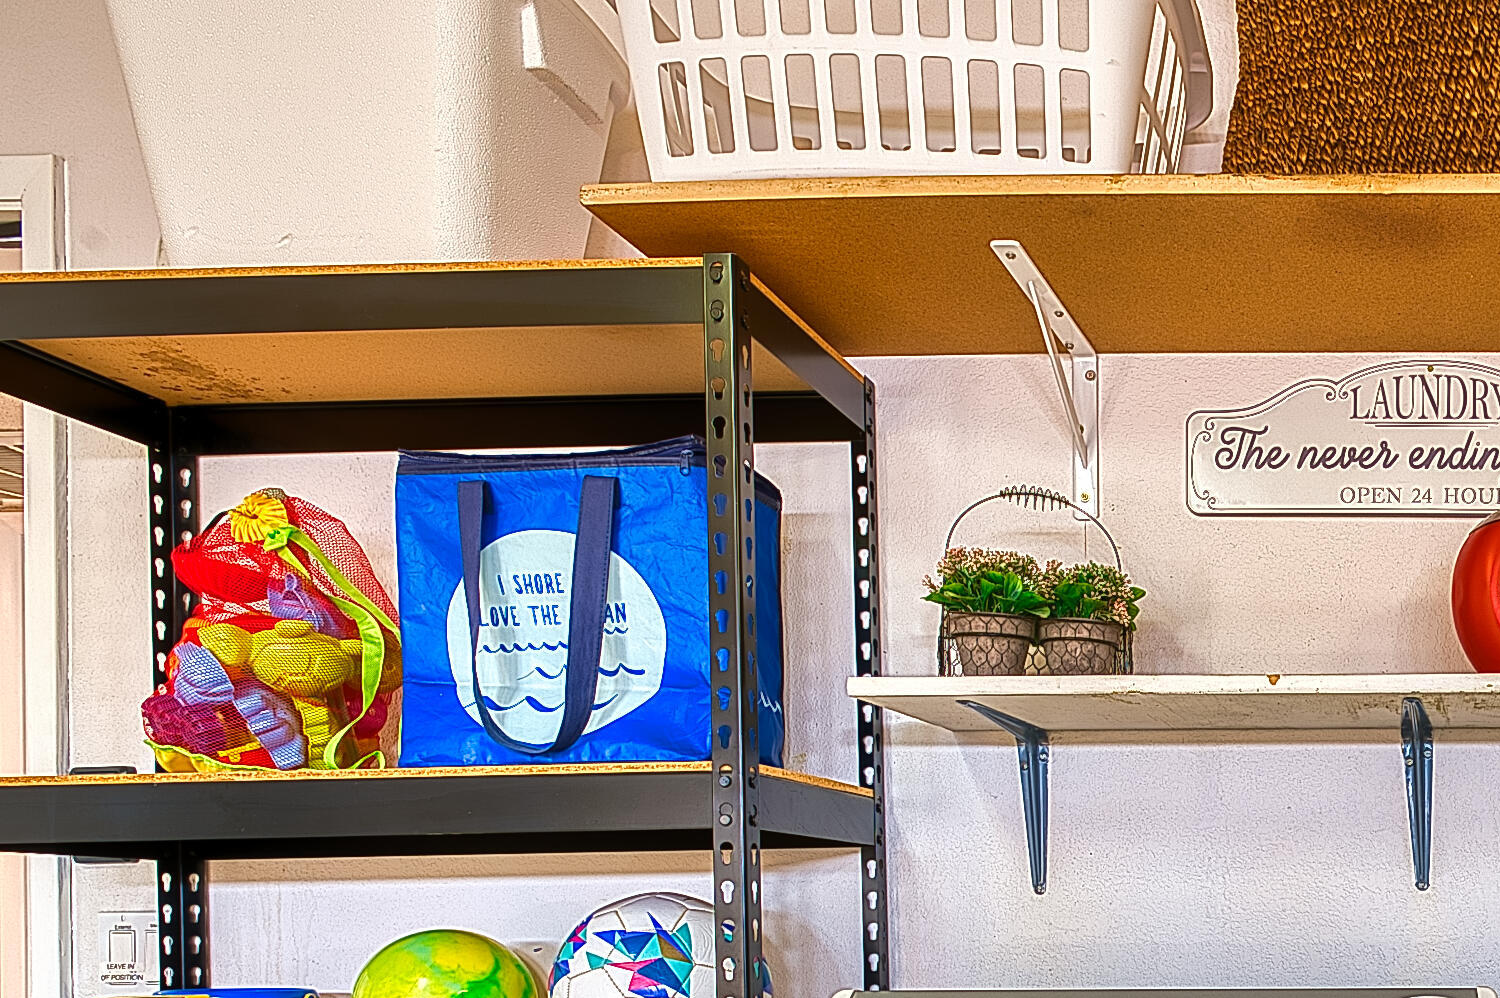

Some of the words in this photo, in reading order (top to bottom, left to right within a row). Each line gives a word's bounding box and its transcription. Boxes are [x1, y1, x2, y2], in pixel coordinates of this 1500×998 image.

[1214, 426, 1291, 471] The
[1296, 439, 1399, 471] never
[1339, 487, 1403, 505] OPEN
[1411, 487, 1433, 505] 24
[497, 574, 505, 595] I
[513, 573, 565, 596] SHORE
[479, 605, 521, 628] LOVE
[526, 605, 562, 626] THE
